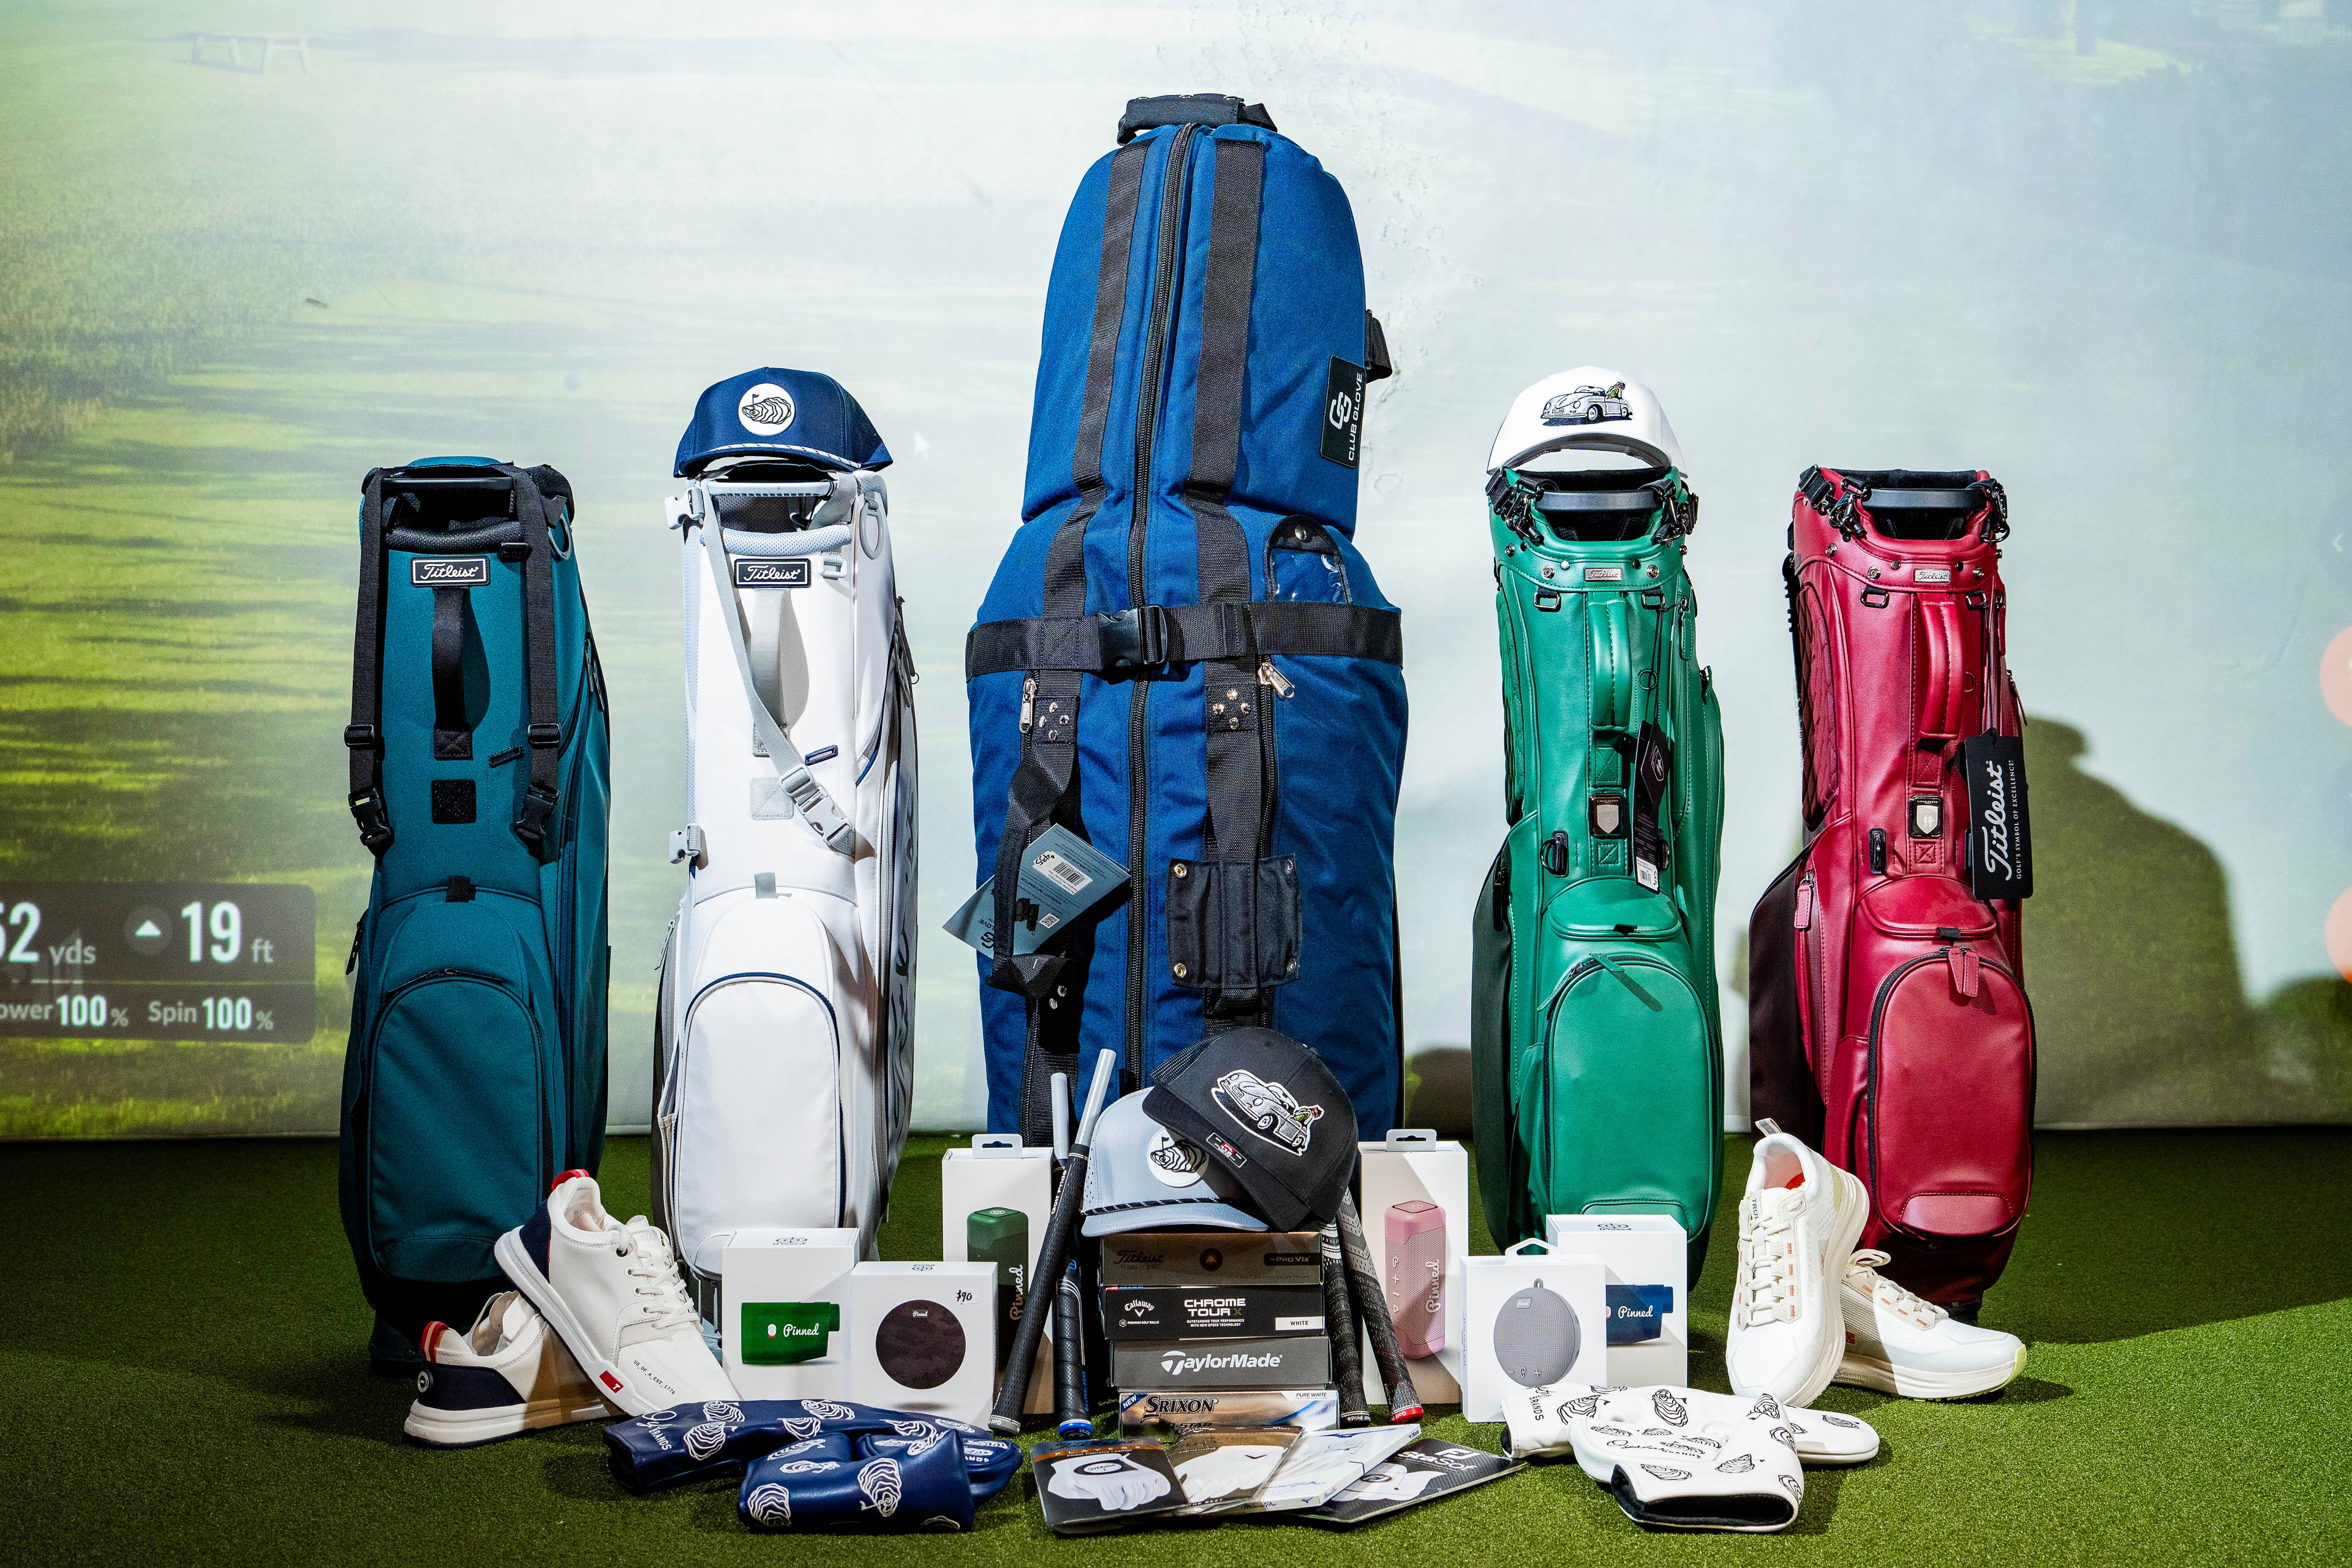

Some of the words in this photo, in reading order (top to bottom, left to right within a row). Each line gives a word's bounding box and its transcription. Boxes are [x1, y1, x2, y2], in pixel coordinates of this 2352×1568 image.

[1352, 372, 1362, 421] GLOVE
[1348, 423, 1357, 461] CLUB
[420, 564, 479, 579] Titleist
[744, 565, 801, 581] Titleist
[1588, 570, 1619, 579] Titleist
[1918, 570, 1949, 581] Titleist
[1981, 760, 2012, 881] Titleist
[2013, 810, 2019, 820] OF
[979, 919, 995, 930] LOVE
[181, 901, 243, 963] 19
[251, 938, 274, 964] ft
[49, 938, 96, 966] yds
[57, 995, 107, 1027] 100
[148, 1001, 198, 1027] Spin
[202, 997, 252, 1030] 100
[1426, 1257, 1441, 1312] Pinned
[956, 1289, 973, 1302] $90
[1009, 1264, 1024, 1321] Pinned
[1125, 1299, 1155, 1311] Callaway
[1184, 1298, 1246, 1308] CHROME
[1188, 1308, 1231, 1317] TOUR
[1618, 1305, 1654, 1319] Pinned
[783, 1323, 820, 1338] Pinned
[1161, 1351, 1283, 1376] TaylorMade
[1123, 1395, 1137, 1409] NEW
[649, 1428, 672, 1450] BRANDS
[1055, 1446, 1141, 1456] PLAYERS
[1398, 1450, 1479, 1471] StaSof
